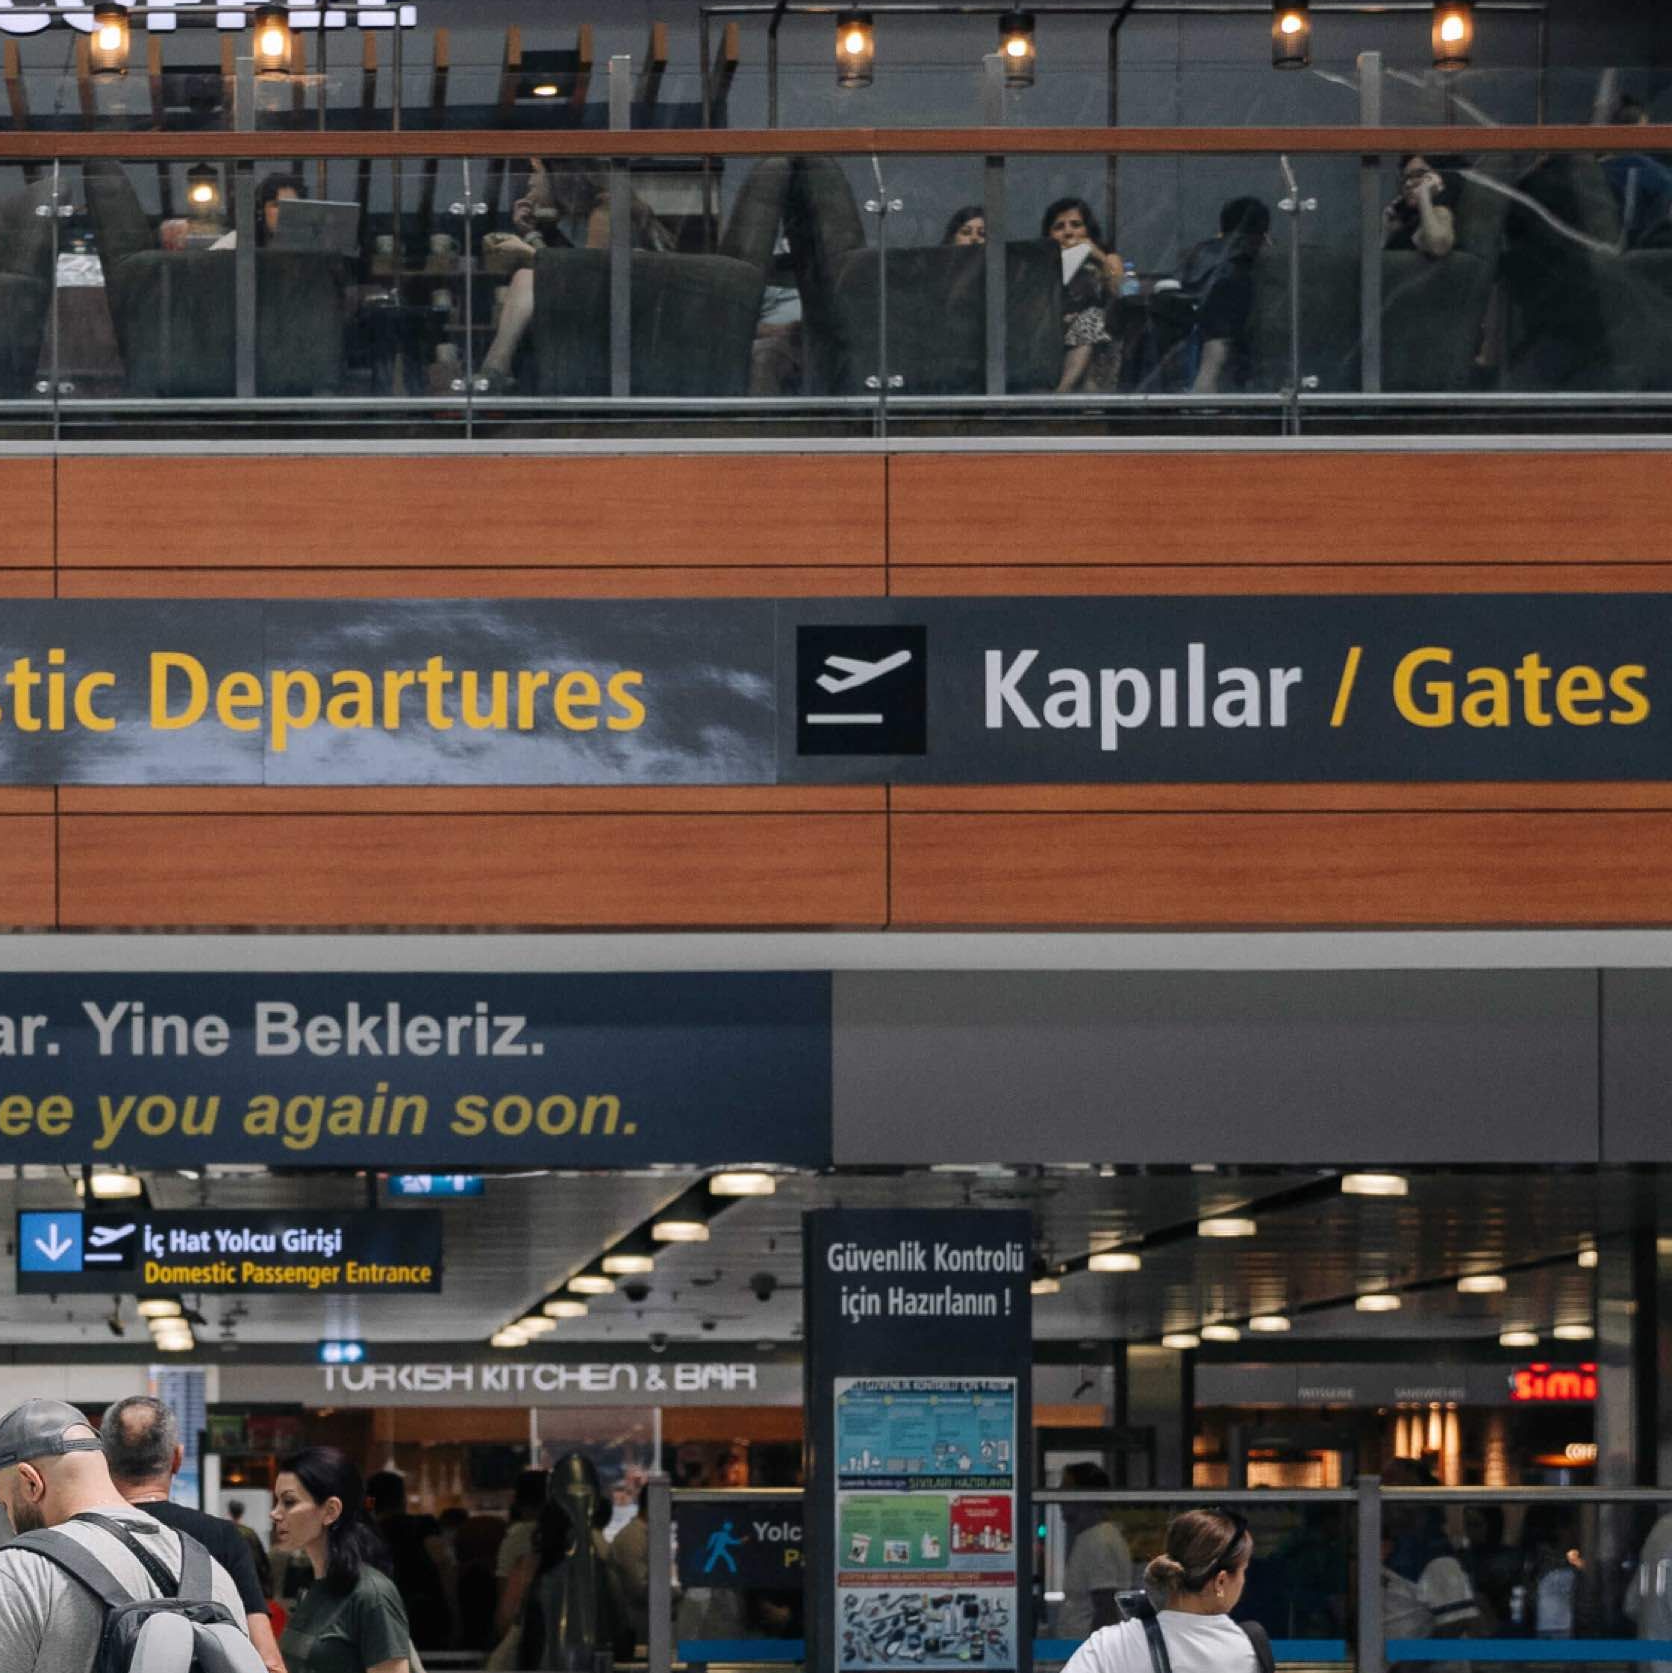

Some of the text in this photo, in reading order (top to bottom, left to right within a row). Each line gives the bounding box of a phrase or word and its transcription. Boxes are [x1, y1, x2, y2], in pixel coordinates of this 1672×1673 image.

[149, 650, 647, 752] Departures
[984, 643, 1303, 750] Kapılar
[1392, 646, 1651, 728] Gates
[82, 1001, 230, 1057] Yine
[255, 1001, 545, 1057] Bekleriz.
[92, 1094, 221, 1151] you
[243, 1081, 429, 1151] again
[451, 1094, 639, 1136] soon.
[144, 1225, 343, 1259] İç Hat Yolcu Girişi
[827, 1240, 1025, 1272] Güvenlik Kontrolü
[144, 1260, 433, 1289] Domestic Passenger Entrance
[841, 1284, 882, 1324] için
[888, 1285, 997, 1316] Hazırlanın
[319, 1363, 757, 1392] TURKISH KITCHEN & BAR
